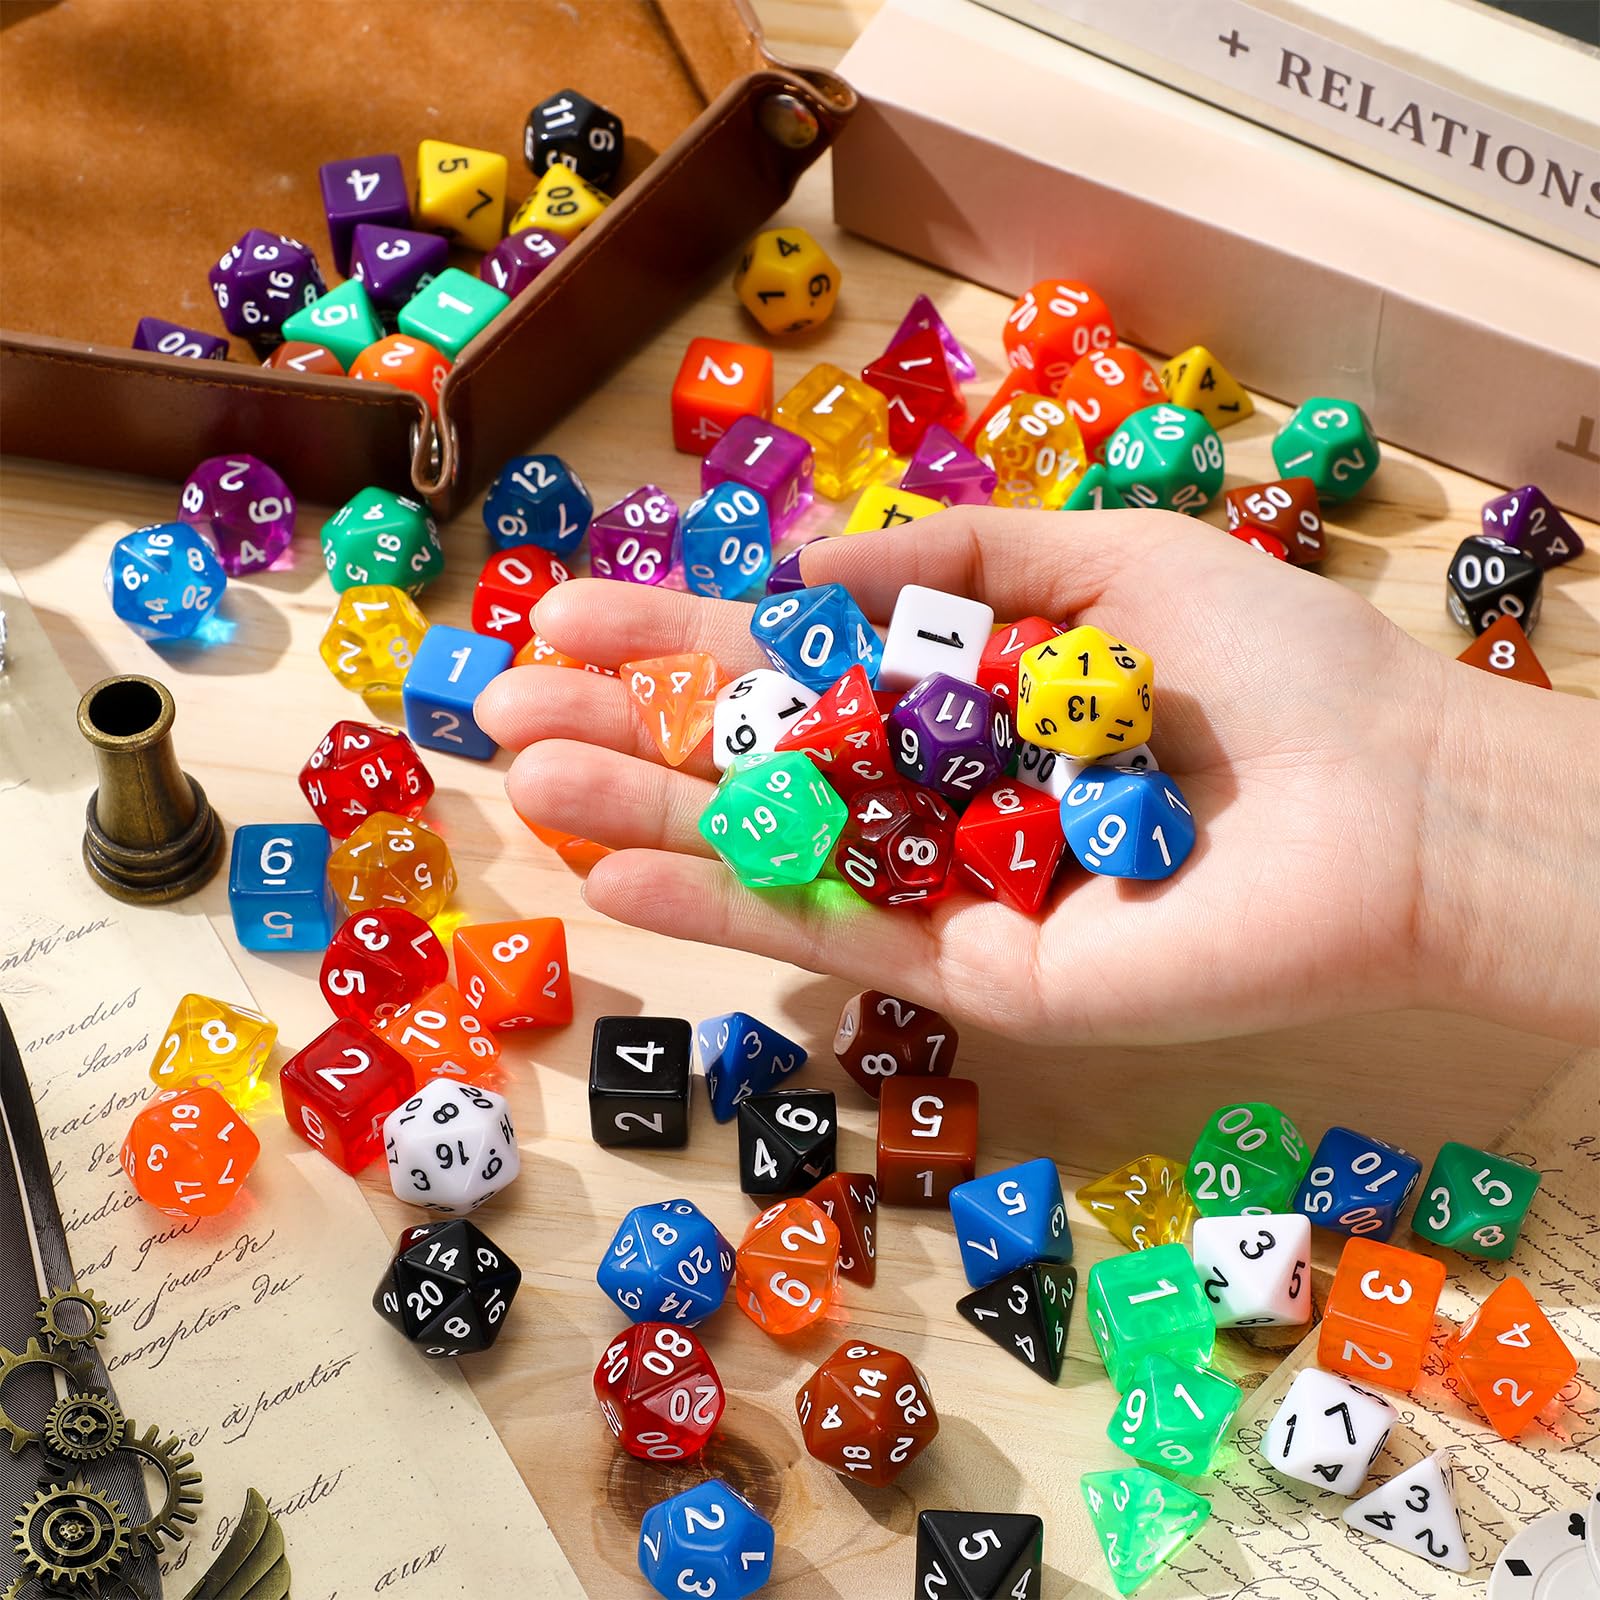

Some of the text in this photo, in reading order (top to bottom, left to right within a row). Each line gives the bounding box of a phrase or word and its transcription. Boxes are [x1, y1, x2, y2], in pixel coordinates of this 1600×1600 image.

[542, 98, 576, 129] 11
[438, 157, 469, 174] 5
[347, 169, 380, 202] 4
[466, 189, 493, 220] 7
[253, 244, 279, 260] 3
[376, 239, 411, 261] 3
[524, 234, 556, 258] 5
[776, 237, 802, 257] 4
[266, 270, 294, 299] 16
[491, 258, 508, 289] 1
[437, 291, 475, 315] 1
[757, 290, 787, 305] 1
[1048, 285, 1090, 318] 10
[381, 342, 416, 367] 2
[698, 355, 744, 386] 2
[1200, 367, 1216, 390] 4
[812, 384, 845, 414] 1
[1066, 398, 1101, 423] 2
[1151, 406, 1186, 440] 40
[1312, 408, 1349, 429] 3
[744, 436, 774, 466] 1
[929, 451, 957, 472] 1
[1332, 448, 1366, 481] 2
[219, 460, 250, 491] 2
[512, 461, 557, 494] 12
[182, 482, 204, 513] 8
[362, 503, 384, 520] 4
[624, 495, 670, 527] 30
[714, 489, 760, 524] 00
[1244, 486, 1293, 521] 50
[558, 503, 579, 539] 7
[1296, 510, 1320, 549] 10
[1529, 507, 1547, 536] 2
[144, 533, 174, 557] 16
[187, 547, 205, 572] 8
[240, 540, 266, 565] 4
[373, 533, 401, 562] 18
[411, 546, 431, 571] 2
[346, 562, 368, 583] 5
[497, 558, 533, 586] 0
[1458, 554, 1505, 588] 00
[144, 598, 173, 624] 14
[182, 585, 212, 610] 20
[352, 601, 390, 622] 7
[486, 604, 522, 631] 4
[759, 598, 800, 628] 8
[388, 637, 414, 669] 8
[800, 623, 834, 668] 0
[856, 623, 873, 664] 4
[917, 629, 964, 649] 1
[1489, 639, 1516, 669] 8
[337, 640, 362, 674] 2
[447, 647, 472, 683] 1
[1077, 652, 1089, 677] 1
[935, 692, 975, 731] 11
[1067, 695, 1101, 722] 13
[344, 735, 370, 750] 2
[431, 711, 463, 744] 2
[361, 757, 392, 788] 18
[941, 755, 985, 790] 12
[1067, 782, 1104, 807] 5
[711, 813, 728, 835] 3
[742, 805, 778, 841] 19
[857, 799, 893, 824] 4
[387, 828, 415, 852] 13
[898, 838, 937, 866] 8
[1009, 830, 1037, 872] 7
[414, 863, 432, 890] 5
[845, 846, 878, 888] 10
[262, 911, 294, 939] 5
[353, 917, 390, 952] 3
[492, 933, 529, 963] 8
[327, 968, 366, 996] 5
[465, 975, 486, 1010] 5
[542, 961, 561, 999] 2
[877, 998, 916, 1028] 2
[200, 1019, 237, 1054] 8
[743, 1031, 762, 1060] 3
[159, 1033, 181, 1075] 2
[616, 1041, 665, 1073] 4
[770, 1053, 795, 1075] 2
[861, 1053, 898, 1077] 8
[926, 1034, 946, 1073] 7
[315, 1048, 371, 1092] 2
[433, 1102, 460, 1124] 8
[458, 1086, 493, 1110] 20
[169, 1104, 200, 1132] 19
[614, 1111, 663, 1134] 2
[911, 1095, 944, 1138] 5
[1217, 1107, 1268, 1152] 00
[147, 1143, 169, 1172] 3
[436, 1140, 469, 1170] 16
[754, 1137, 778, 1179] 4
[411, 1168, 431, 1192] 3
[916, 1170, 934, 1198] 1
[1194, 1161, 1242, 1200] 20
[1350, 1152, 1398, 1193] 10
[1471, 1168, 1513, 1207] 5
[996, 1180, 1027, 1216] 5
[1124, 1174, 1148, 1206] 2
[1304, 1166, 1335, 1214] 50
[1051, 1204, 1065, 1238] 3
[1338, 1207, 1384, 1234] 00
[1428, 1186, 1451, 1230] 3
[651, 1222, 678, 1246] 8
[780, 1219, 826, 1252] 2
[1239, 1230, 1276, 1260] 3
[1472, 1225, 1505, 1247] 8
[425, 1242, 460, 1272] 14
[678, 1245, 713, 1286] 20
[1127, 1277, 1180, 1306] 1
[1204, 1266, 1229, 1304] 2
[1288, 1260, 1306, 1300] 5
[1360, 1269, 1413, 1305] 3
[383, 1291, 400, 1313] 2
[406, 1280, 444, 1321] 20
[484, 1288, 506, 1324] 16
[1007, 1284, 1029, 1315] 3
[444, 1316, 471, 1339] 8
[1496, 1322, 1532, 1349] 4
[642, 1328, 694, 1376] 80
[1014, 1333, 1036, 1363] 4
[1341, 1340, 1393, 1371] 2
[853, 1367, 888, 1400] 14
[1492, 1377, 1533, 1407] 2
[668, 1385, 718, 1425] 20
[895, 1383, 928, 1426] 20
[1173, 1383, 1205, 1421] 1
[820, 1404, 844, 1431] 4
[1324, 1401, 1356, 1445] 7
[889, 1437, 914, 1464] 2
[1283, 1413, 1297, 1458] 1
[842, 1445, 873, 1473] 18
[1312, 1463, 1344, 1482] 4
[1113, 1480, 1130, 1512] 3
[1405, 1485, 1430, 1513] 3
[684, 1503, 726, 1535] 2
[1364, 1511, 1396, 1531] 4
[958, 1528, 1002, 1561] 5
[1415, 1528, 1449, 1558] 2
[740, 1551, 766, 1571] 1
[677, 1568, 717, 1599] 3
